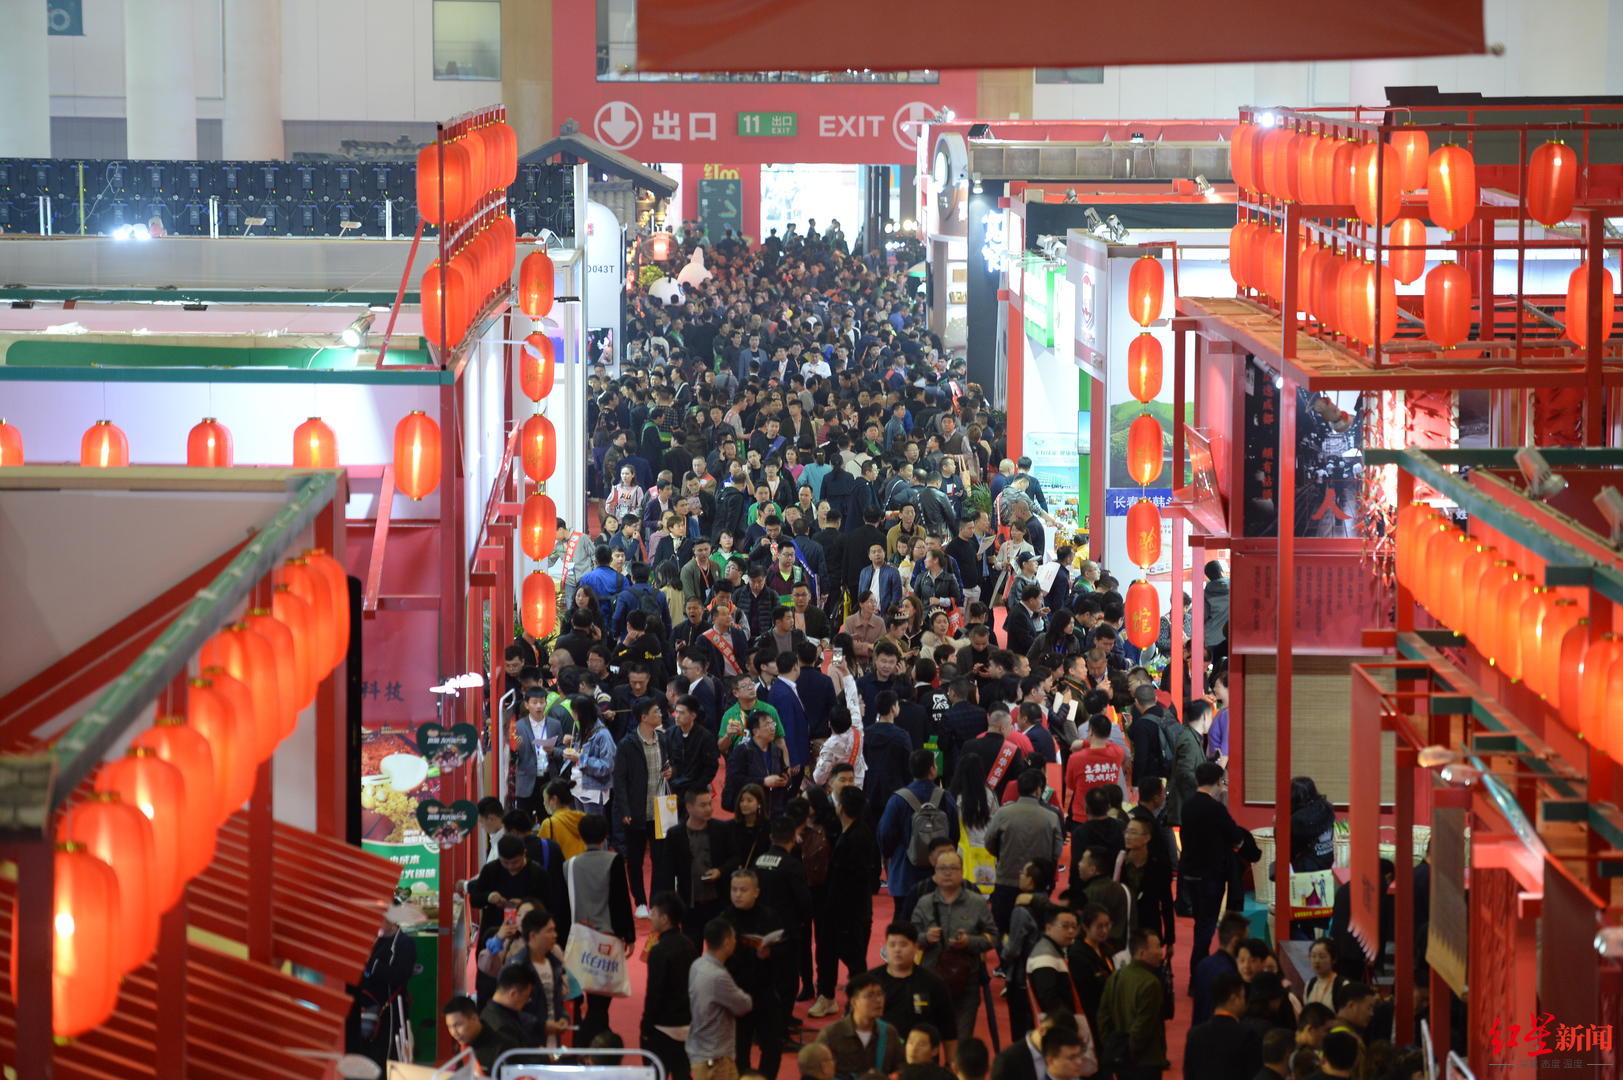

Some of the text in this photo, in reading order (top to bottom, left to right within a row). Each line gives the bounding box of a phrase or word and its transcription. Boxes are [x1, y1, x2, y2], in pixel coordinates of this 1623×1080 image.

[652, 110, 717, 141] 出口
[743, 115, 760, 133] 11
[772, 115, 792, 127] 出口
[819, 115, 885, 137] EXIT
[1312, 488, 1352, 520] 人
